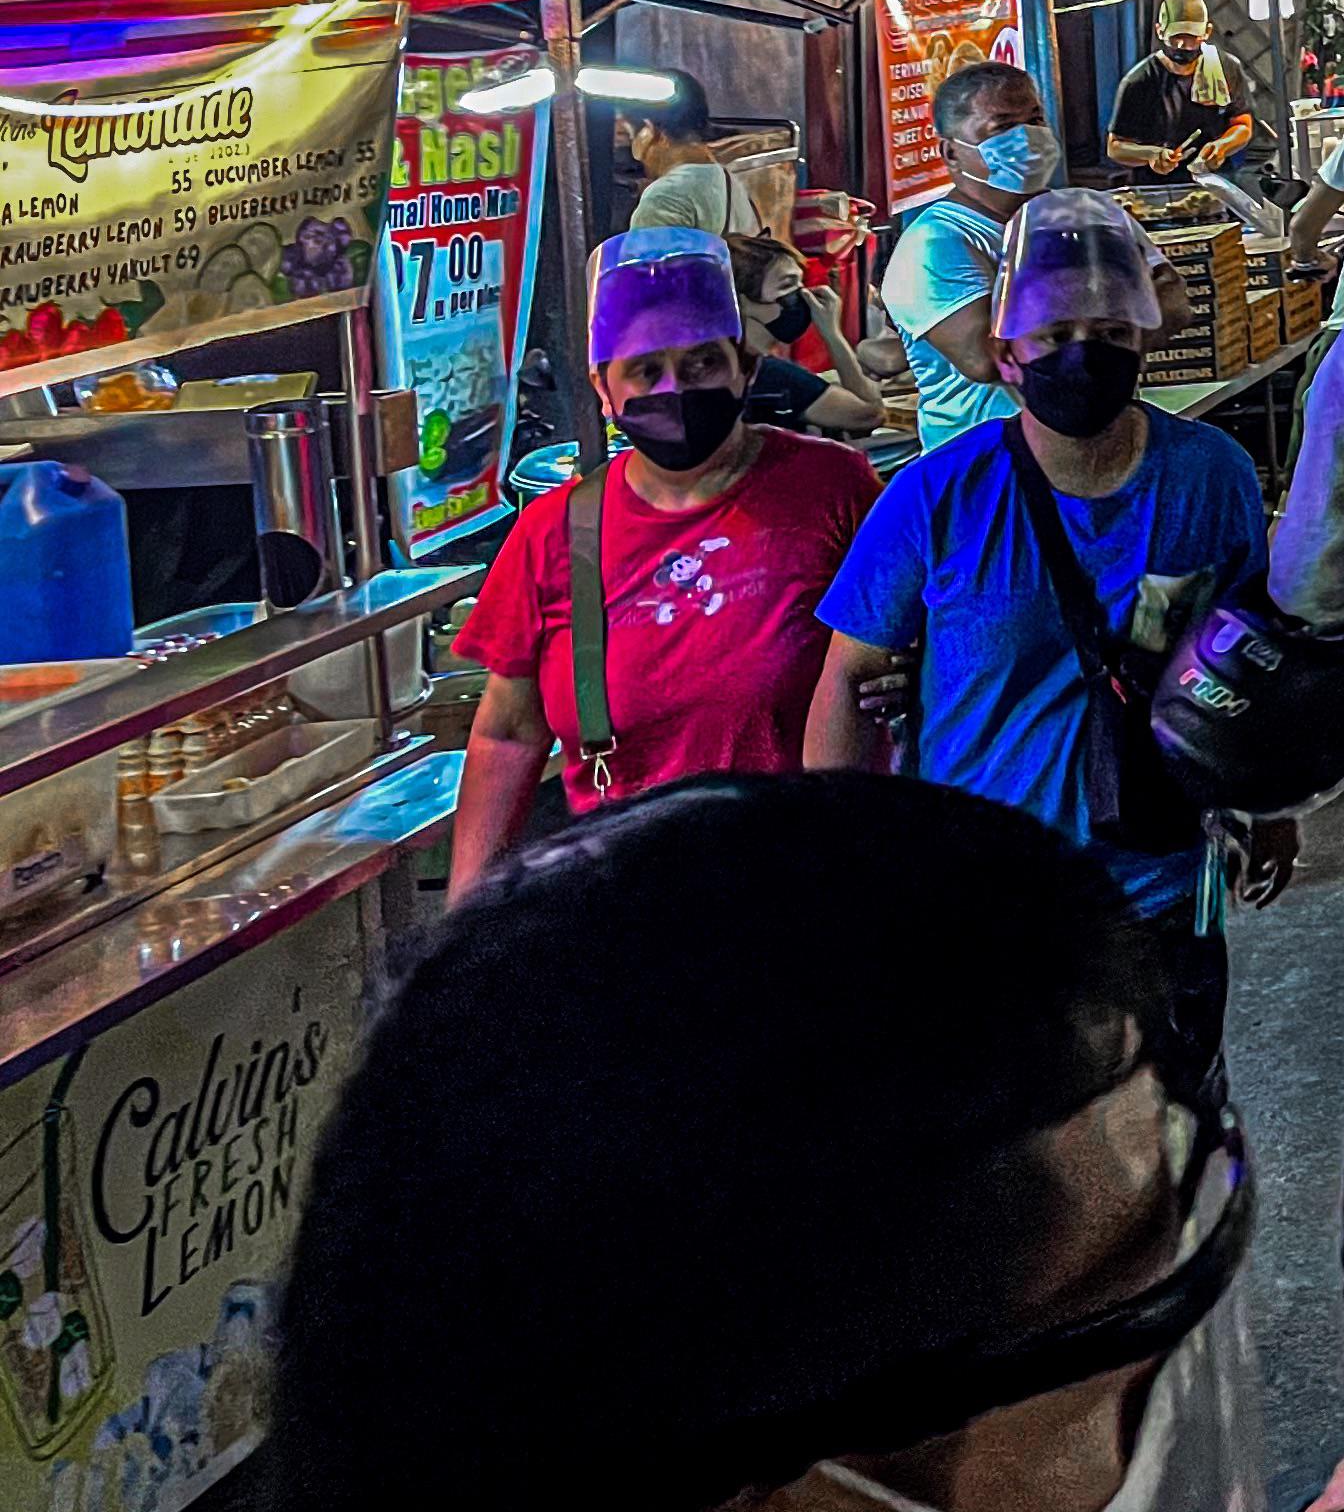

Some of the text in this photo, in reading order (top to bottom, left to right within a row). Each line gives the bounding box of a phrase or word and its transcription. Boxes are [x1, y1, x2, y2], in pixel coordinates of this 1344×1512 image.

[41, 87, 253, 183] Lemonade
[205, 157, 291, 187] CUCUMBER
[355, 139, 376, 163] 55
[19, 193, 79, 219] LEMON
[171, 169, 192, 194] 55
[208, 192, 298, 226] BLUEBERRY
[303, 182, 352, 205] LEMON
[432, 191, 482, 227] Home
[106, 217, 164, 245] LEMON
[174, 206, 197, 232] 59
[107, 254, 172, 285] YAKULT
[175, 244, 200, 270] 69
[92, 986, 329, 1244] Calvin's
[160, 1093, 298, 1237] FRESH
[141, 1156, 297, 1317] LEMON
